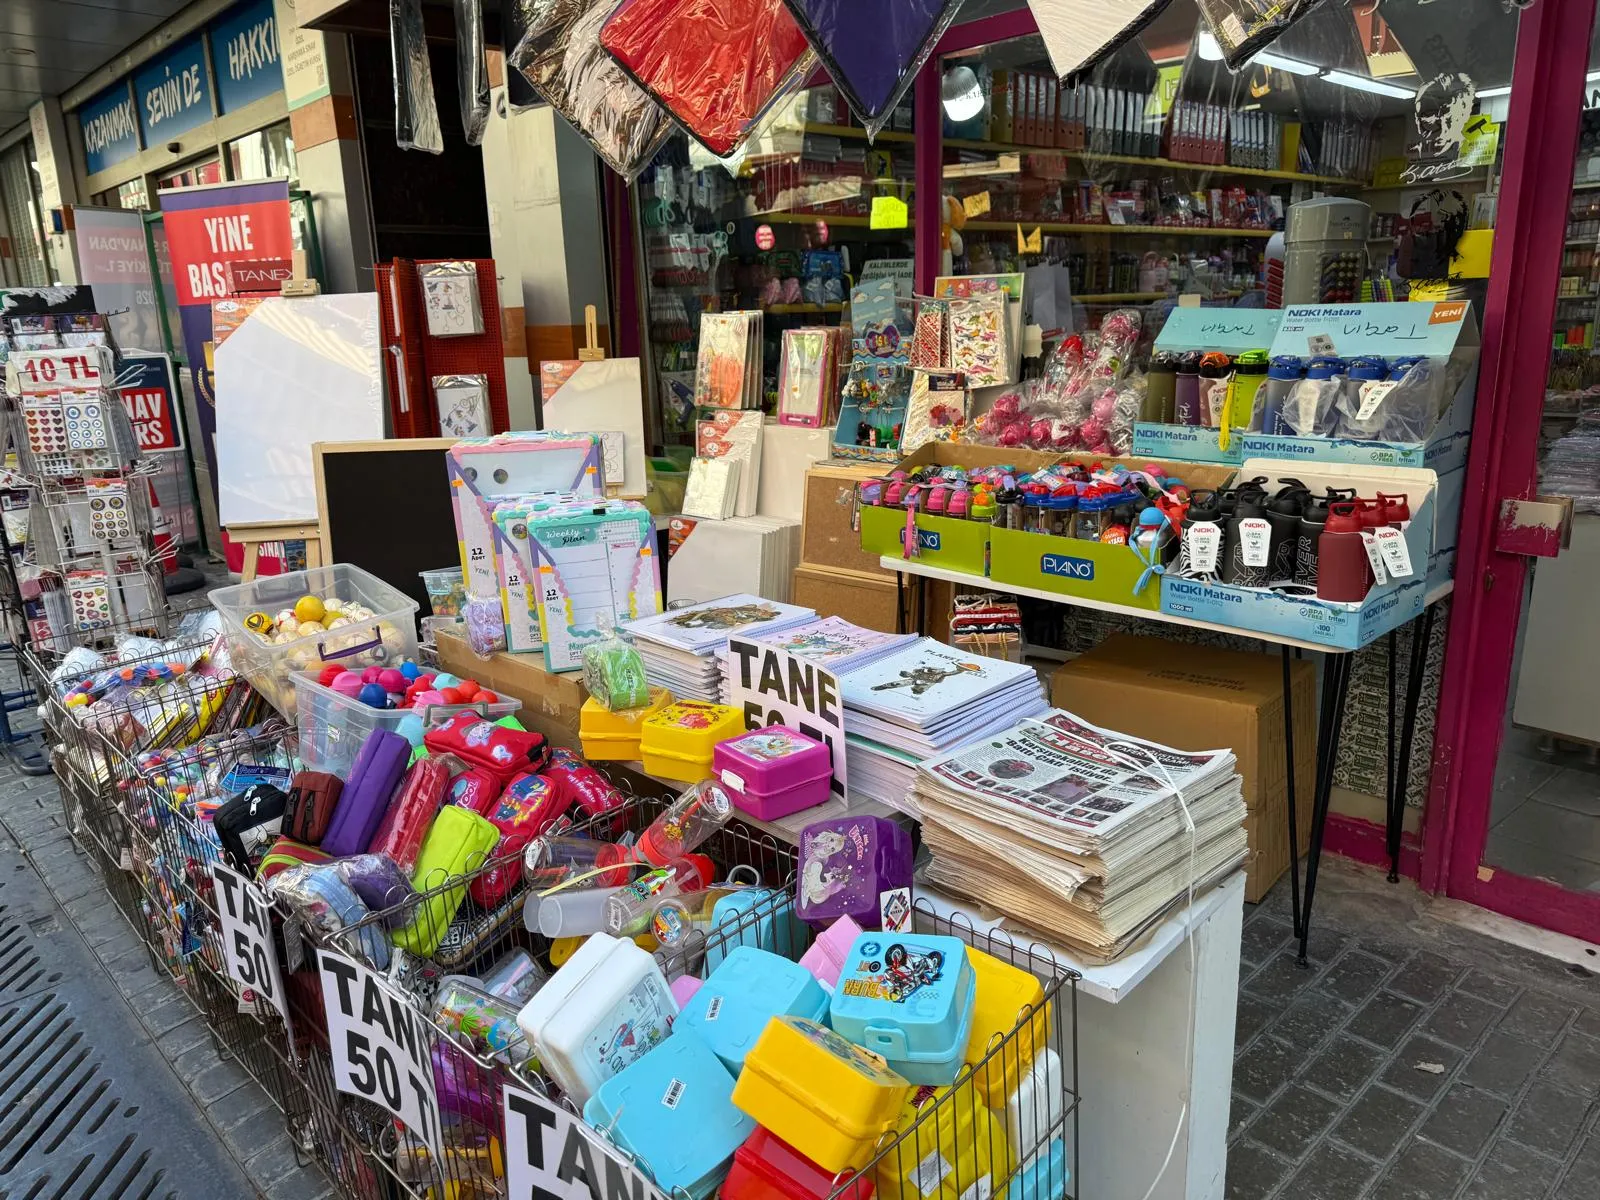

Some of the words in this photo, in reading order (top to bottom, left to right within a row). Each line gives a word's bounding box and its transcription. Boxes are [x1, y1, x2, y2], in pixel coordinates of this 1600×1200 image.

[146, 65, 181, 128] SENİN
[182, 63, 202, 108] DE
[83, 98, 135, 154] KAZANMAK
[1288, 309, 1320, 317] NOKI
[1321, 308, 1362, 316] Matara
[1433, 307, 1462, 319] YENİ
[25, 357, 57, 382] 10
[61, 355, 99, 380] TL
[1136, 429, 1163, 438] NOKI
[1164, 432, 1198, 441] Matara
[1243, 441, 1275, 450] NOKI
[1276, 443, 1315, 454] Matara
[545, 528, 581, 538] Weekly
[1378, 531, 1398, 539] NOKI
[562, 535, 587, 545] Plan
[471, 547, 483, 555] 12
[1170, 582, 1202, 596] NOKI
[1203, 587, 1243, 604] Matara
[1308, 608, 1323, 616] BPA
[1363, 607, 1381, 621] NOKI
[730, 639, 840, 728] TANE
[1099, 766, 1119, 776] da
[234, 928, 272, 999] 50
[346, 1029, 402, 1112] 50
